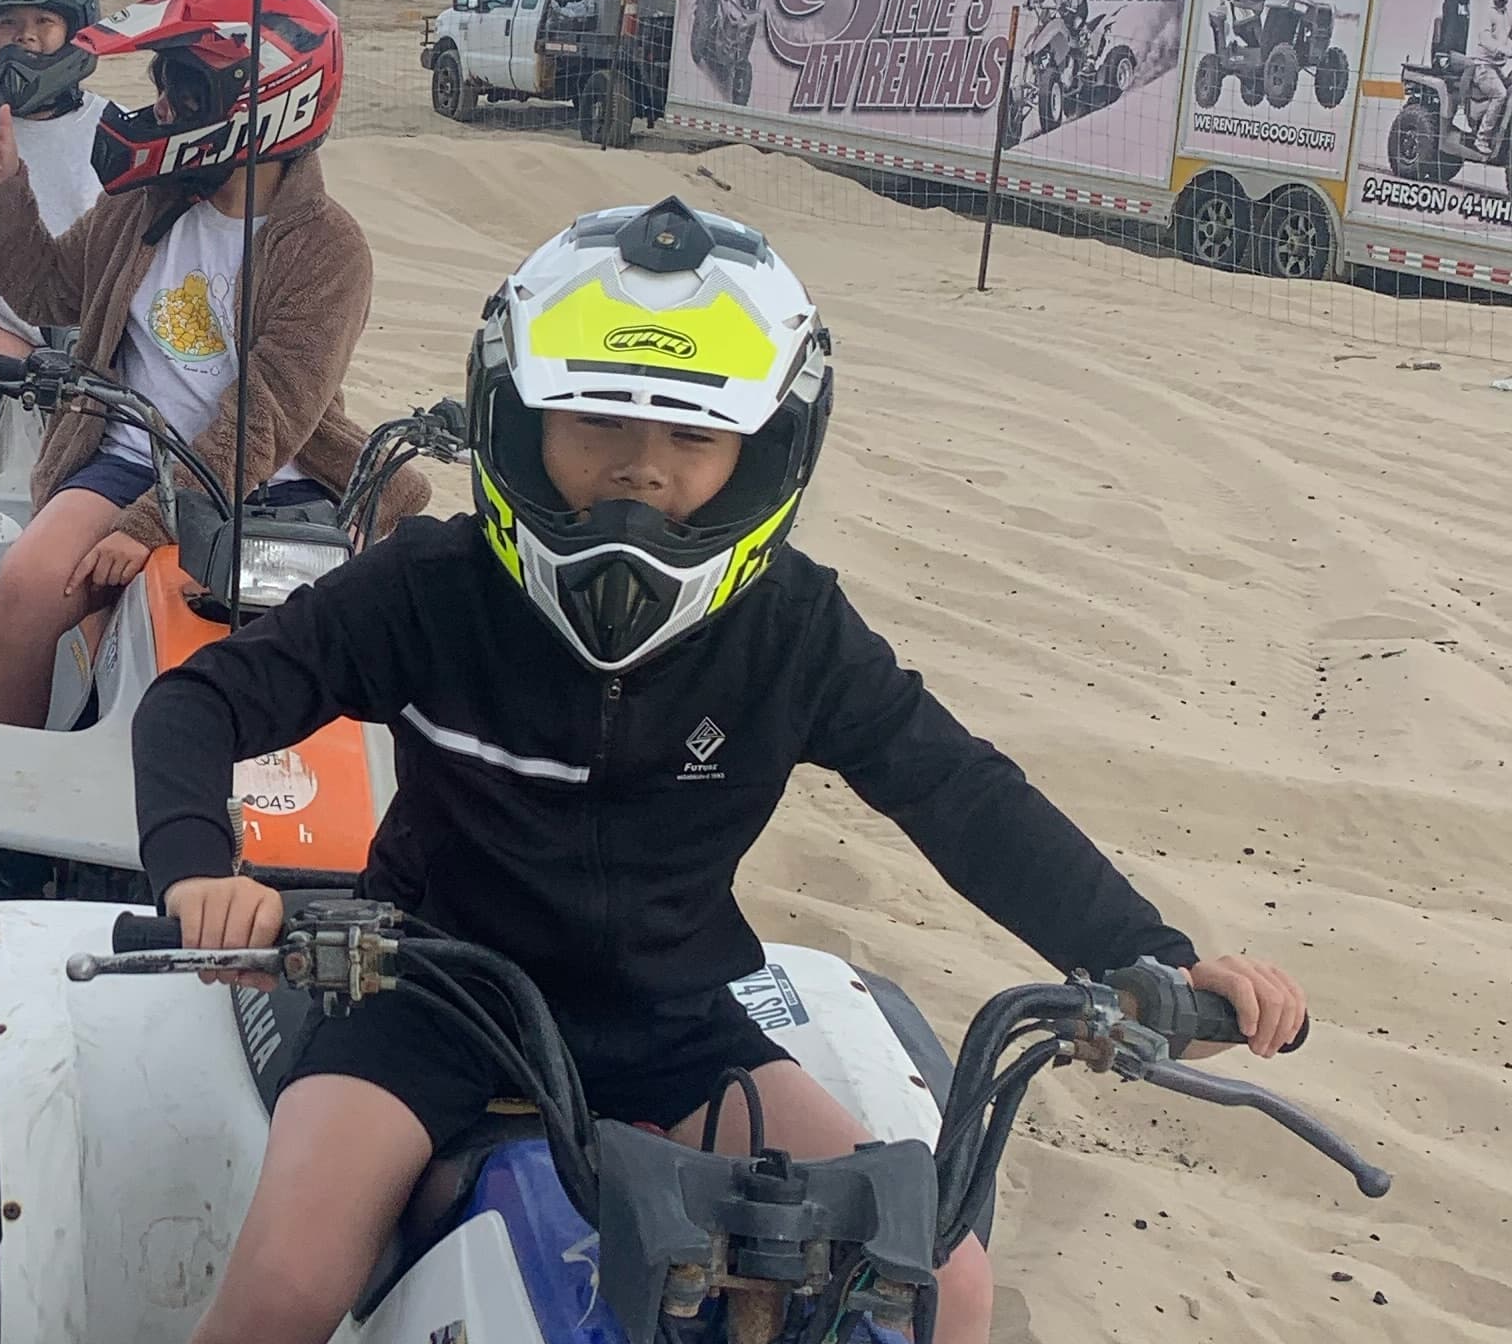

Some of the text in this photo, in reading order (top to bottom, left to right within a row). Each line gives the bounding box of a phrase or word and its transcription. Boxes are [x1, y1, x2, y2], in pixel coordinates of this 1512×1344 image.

[792, 35, 1010, 111] ATV RENTALS
[1194, 113, 1337, 152] WE RENT THE GOOD STUFF!
[1362, 178, 1512, 227] 2-PERSON 4-WH
[255, 794, 296, 811] 045
